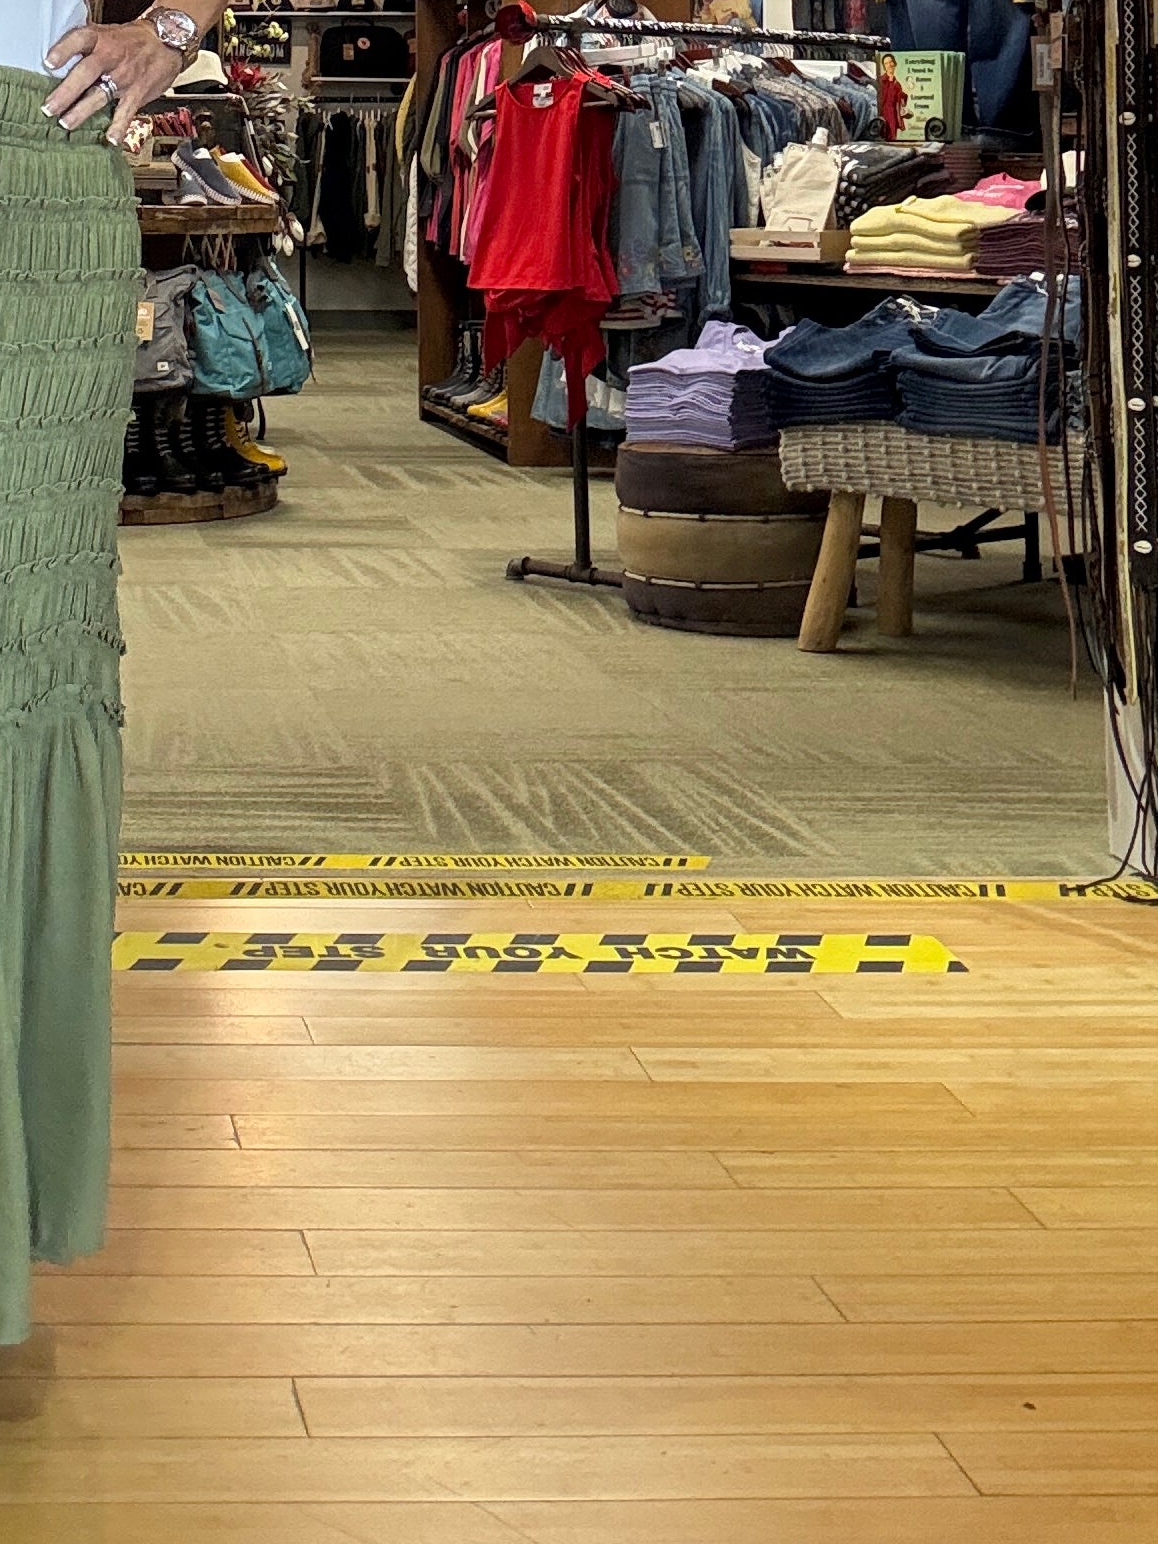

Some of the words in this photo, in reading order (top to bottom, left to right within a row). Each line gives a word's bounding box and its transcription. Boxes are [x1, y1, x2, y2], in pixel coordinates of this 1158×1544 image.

[144, 855, 212, 866] WATCH
[216, 855, 296, 866] CAUTION
[399, 856, 449, 867] STEP
[450, 856, 504, 867] YOUR
[505, 856, 577, 867] WATCH
[576, 856, 661, 867] CAUTION
[265, 881, 321, 896] STEP
[322, 881, 387, 896] YOUR
[384, 882, 467, 896] WATCH
[466, 882, 563, 896] CAUTION
[675, 883, 736, 896] STEP
[735, 883, 802, 897] YOUR
[797, 883, 883, 897] WATCH
[878, 883, 978, 897] CAUTION
[242, 945, 385, 958] STEP
[421, 946, 584, 959] YOUR
[613, 946, 818, 959] WATCH
